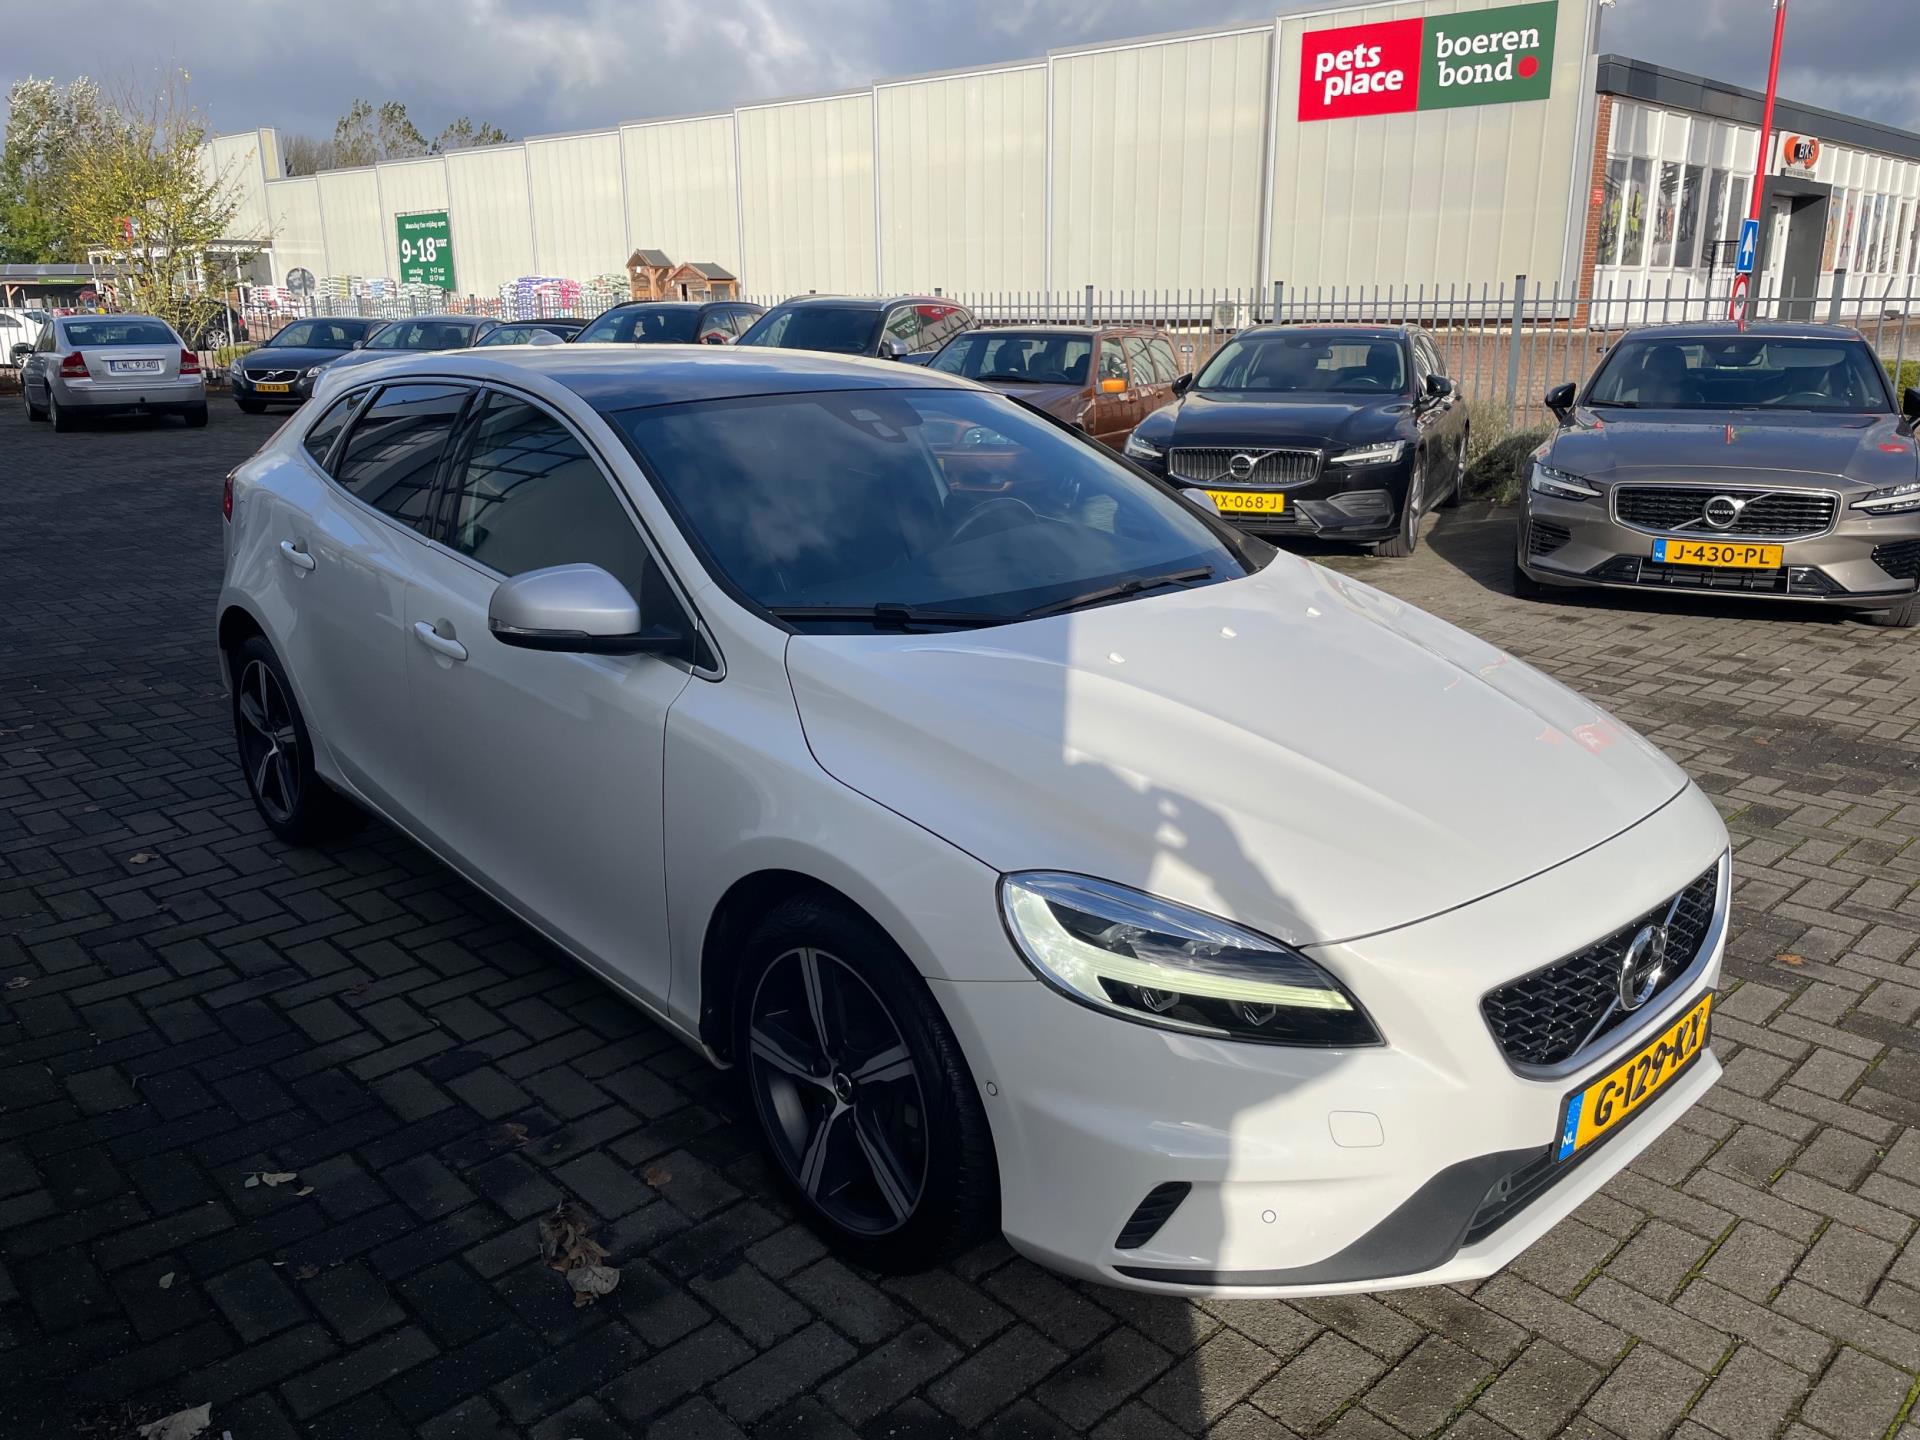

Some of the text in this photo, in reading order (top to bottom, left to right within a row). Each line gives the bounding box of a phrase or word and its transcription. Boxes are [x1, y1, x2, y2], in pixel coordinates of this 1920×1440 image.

[1435, 28, 1540, 59] boeren
[1314, 42, 1381, 81] pets
[1438, 54, 1513, 87] bond
[1323, 68, 1404, 105] place
[1798, 143, 1815, 160] BKS
[401, 237, 447, 264] 9-18 uur
[1655, 551, 1664, 559] NL
[1674, 544, 1770, 565] J-430-PL
[1593, 1006, 1705, 1127] G-129-KX
[1561, 1130, 1575, 1149] NL
